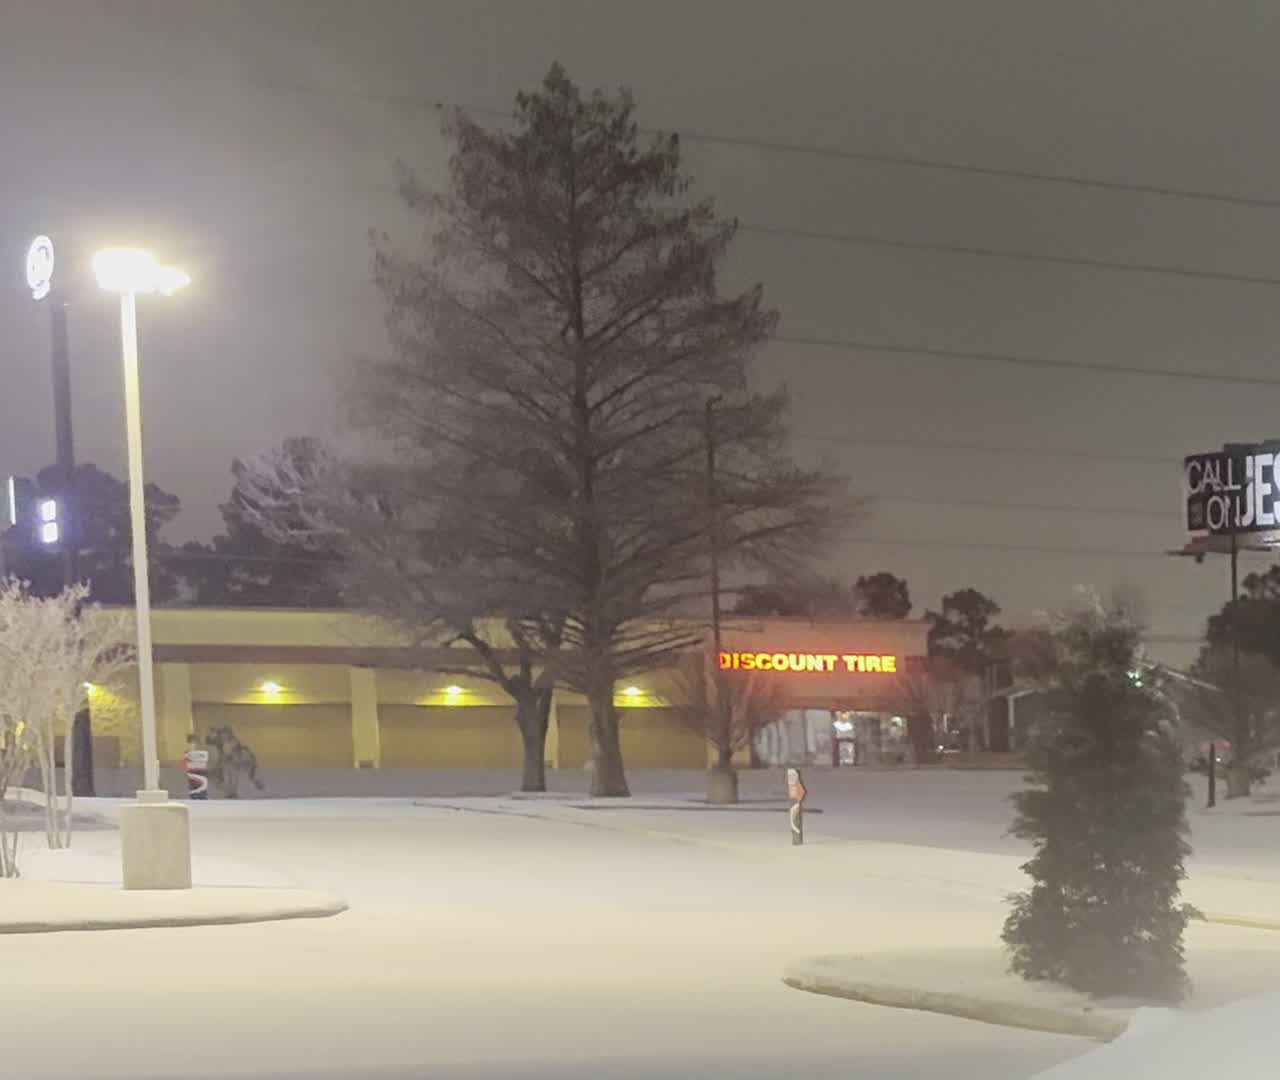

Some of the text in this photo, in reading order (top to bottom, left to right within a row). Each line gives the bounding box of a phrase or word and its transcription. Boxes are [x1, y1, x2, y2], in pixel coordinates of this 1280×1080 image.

[1186, 457, 1241, 495] CALL
[1206, 495, 1241, 530] ON
[719, 652, 897, 673] DISCOUNT TIRE
